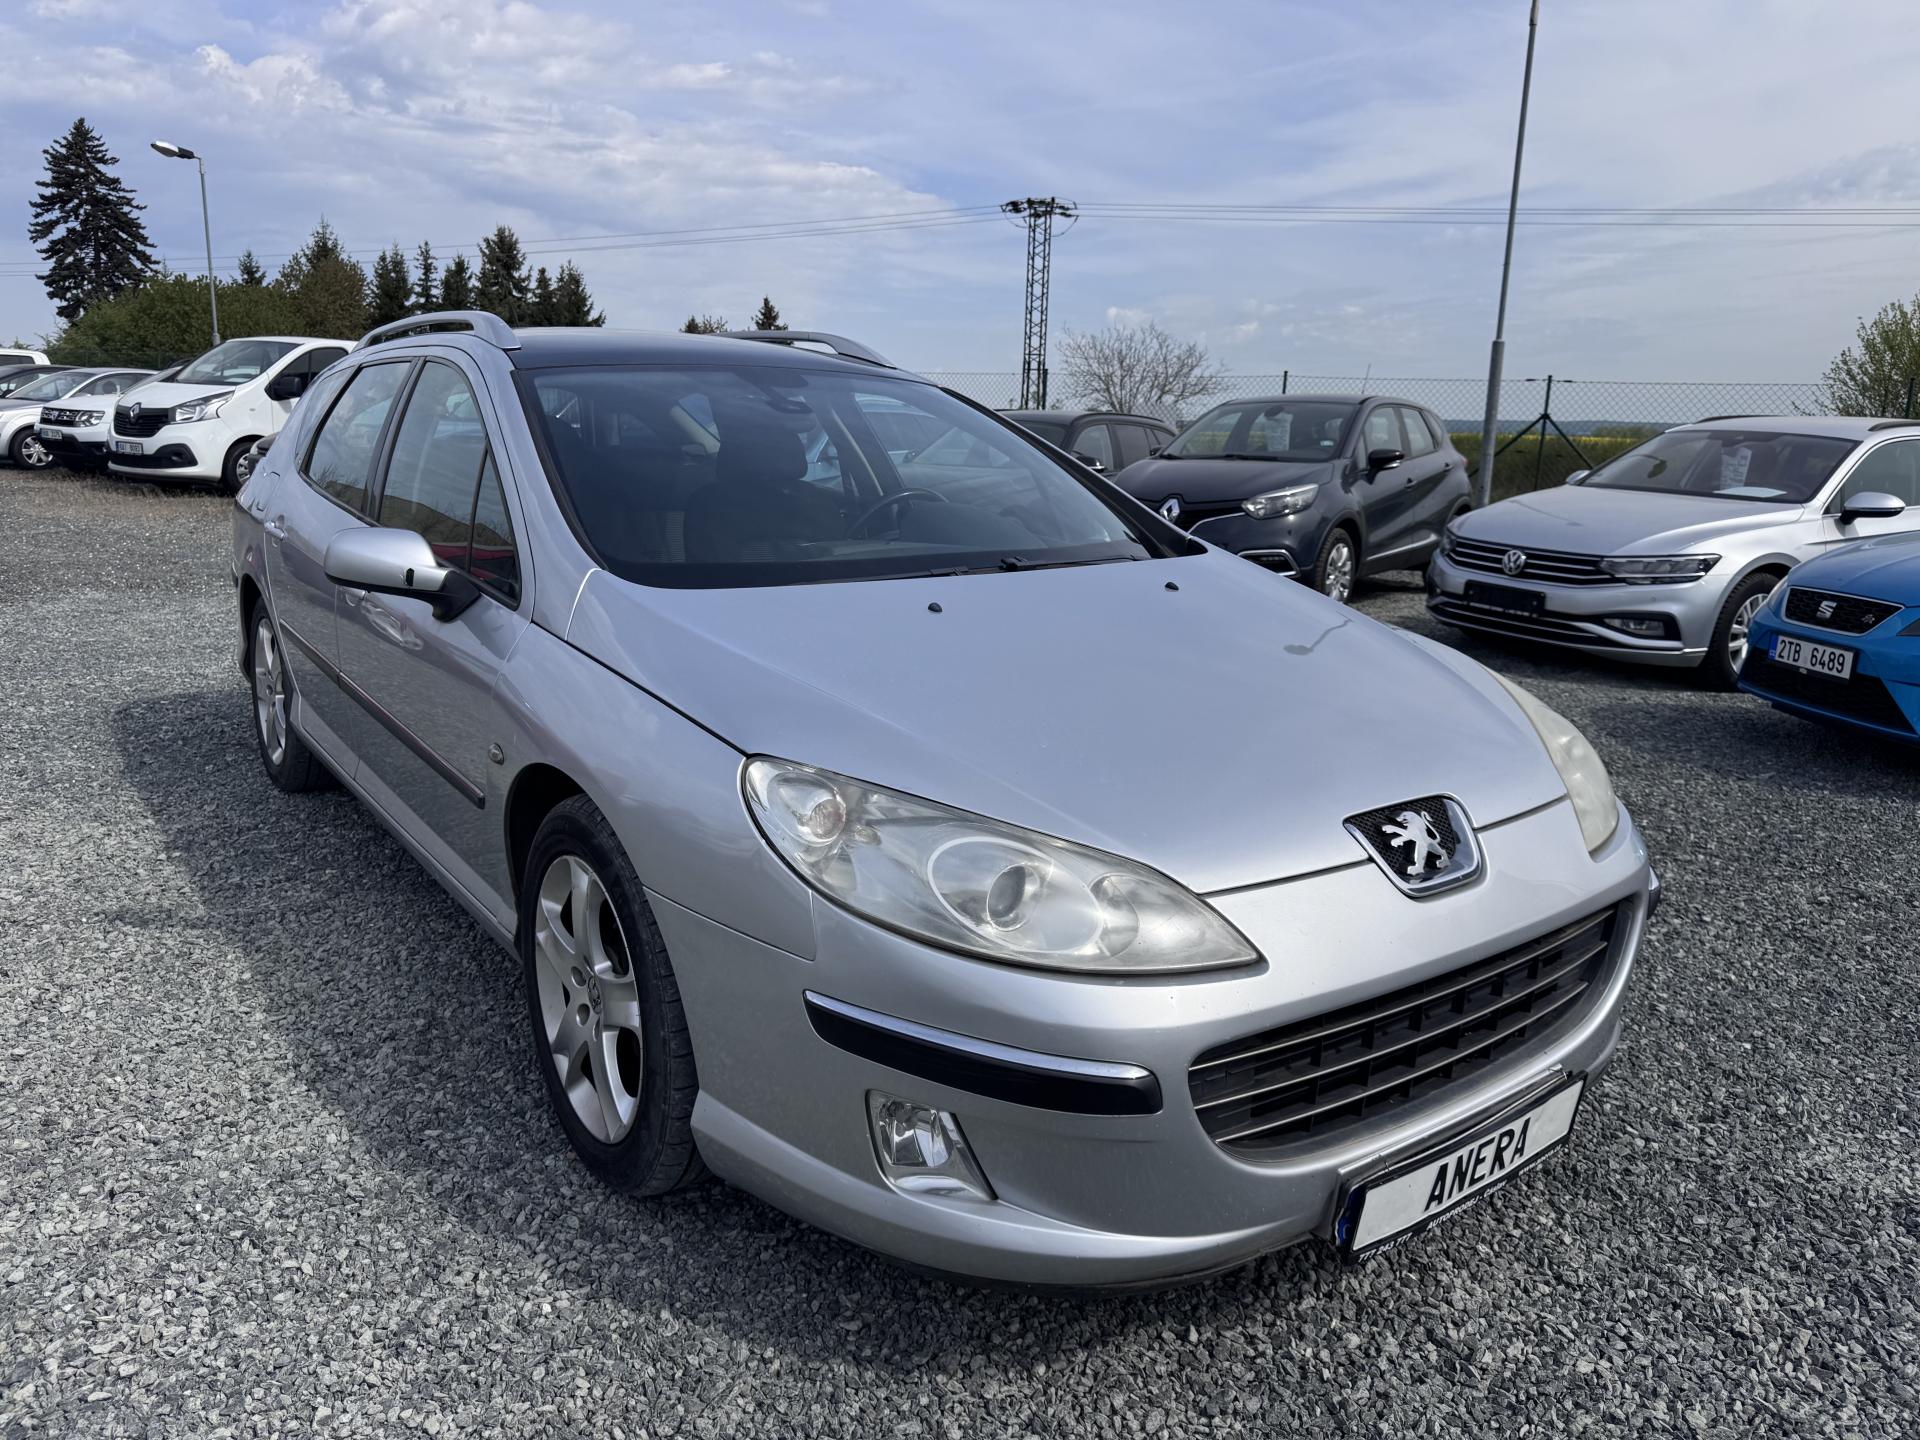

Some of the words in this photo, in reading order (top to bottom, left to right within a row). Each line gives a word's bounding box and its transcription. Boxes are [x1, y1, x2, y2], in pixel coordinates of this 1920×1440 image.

[1777, 639, 1802, 663] 2TB
[1810, 647, 1846, 674] 6489
[1424, 1117, 1531, 1212] ANERA
